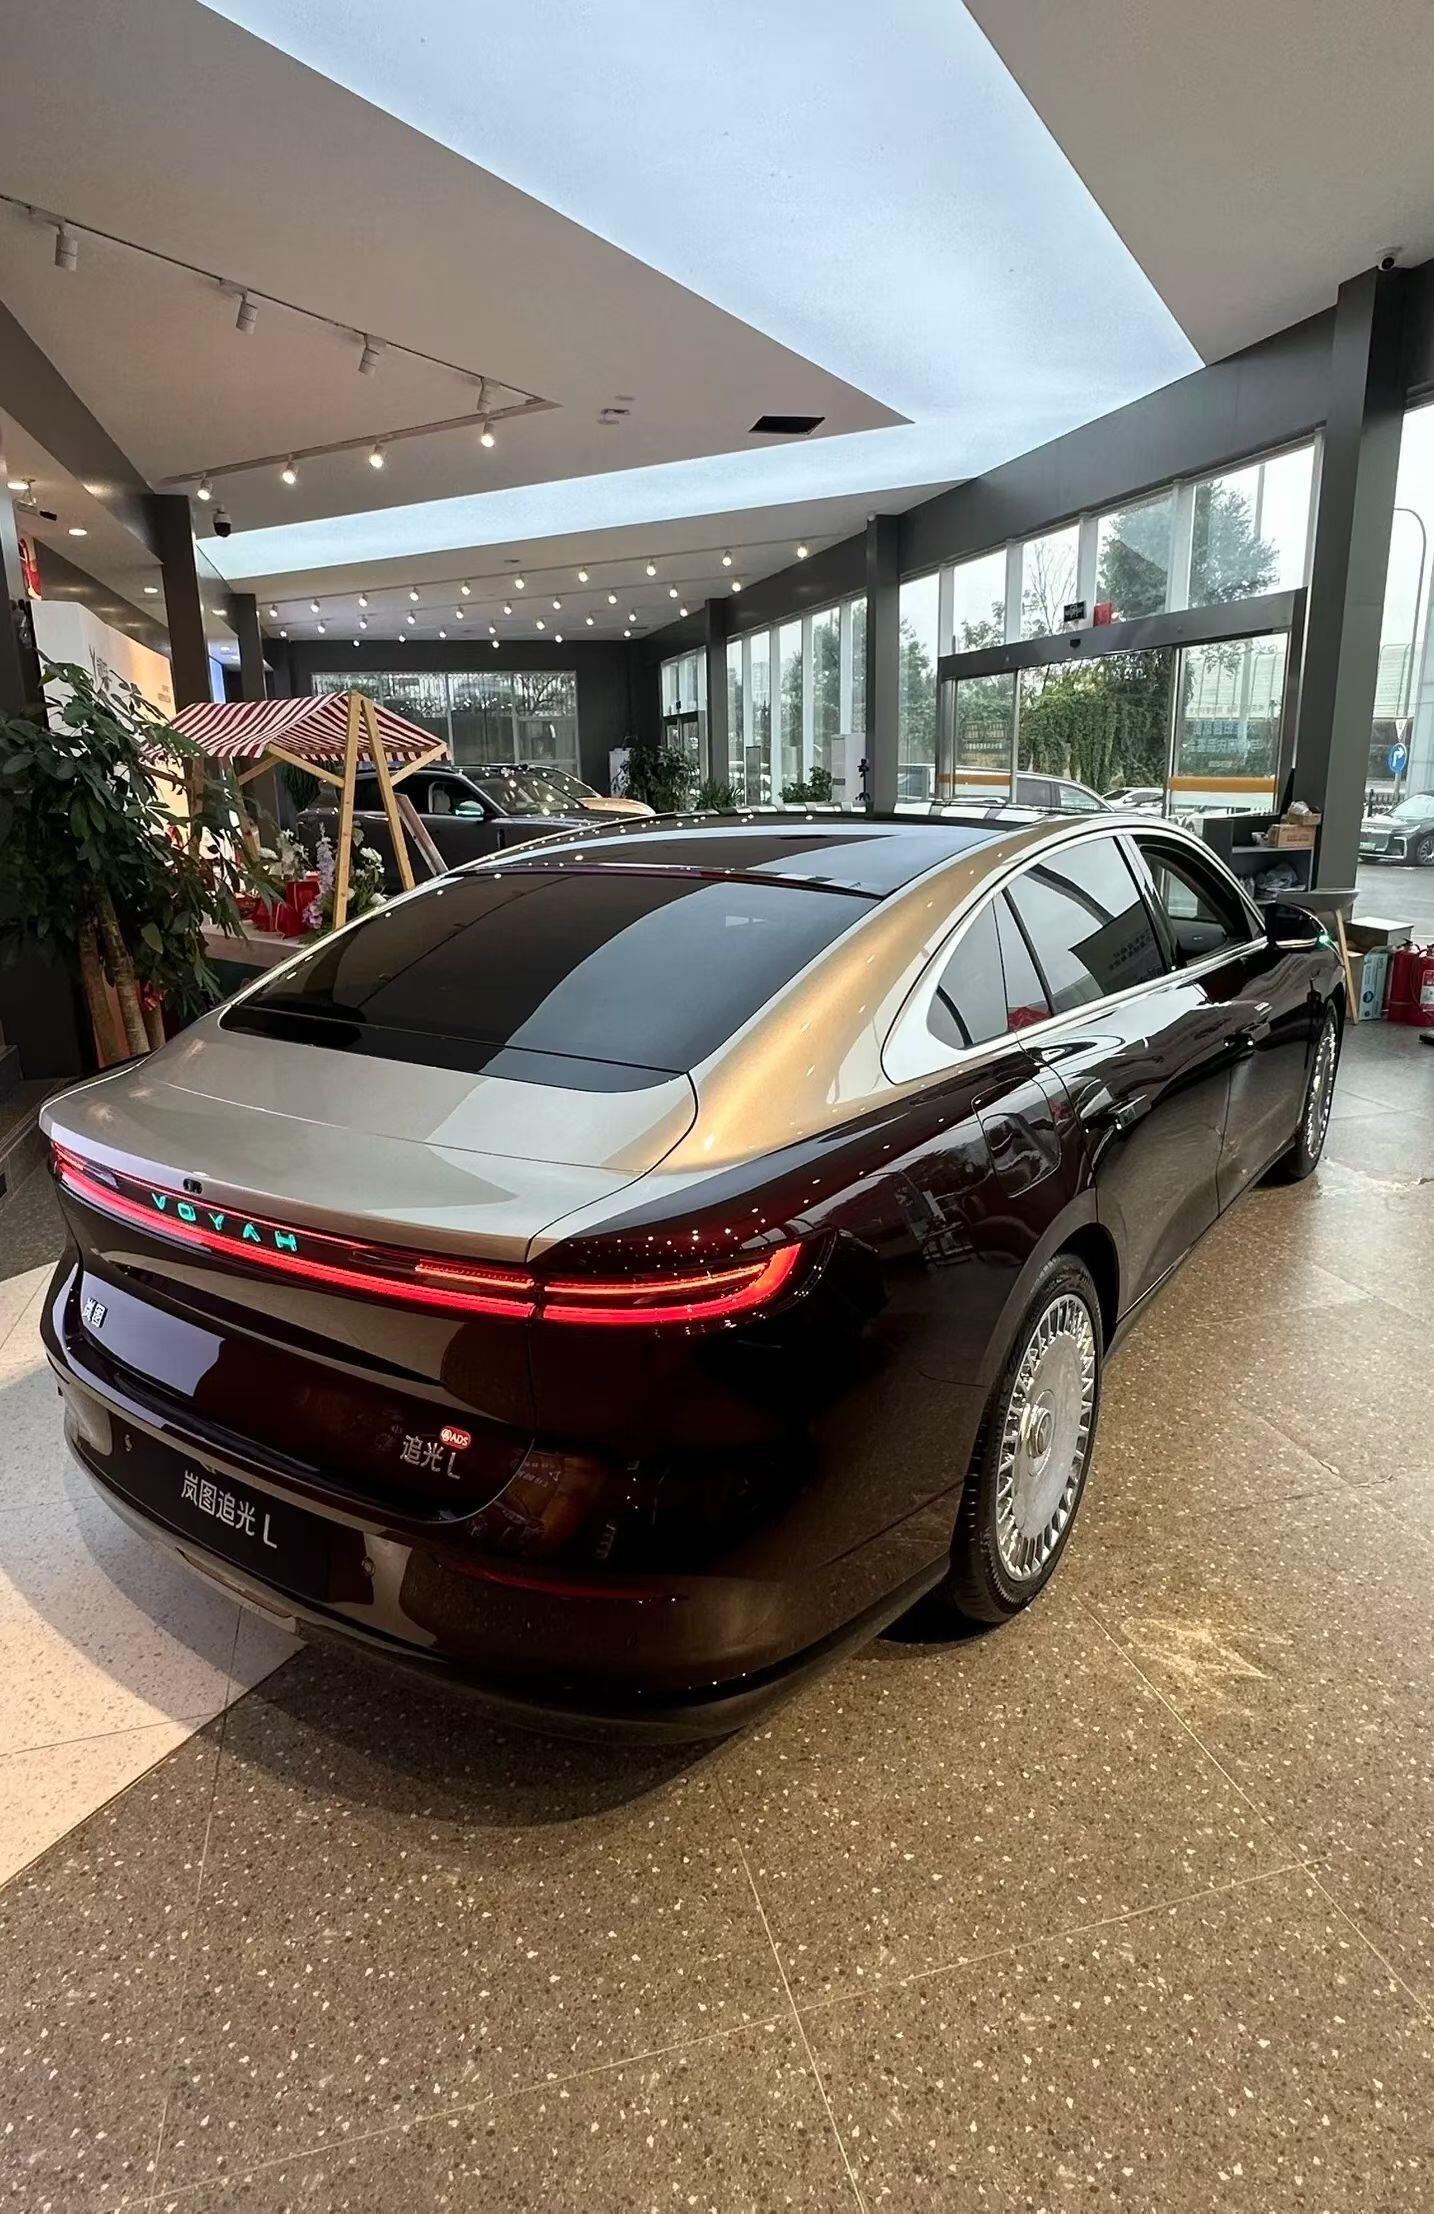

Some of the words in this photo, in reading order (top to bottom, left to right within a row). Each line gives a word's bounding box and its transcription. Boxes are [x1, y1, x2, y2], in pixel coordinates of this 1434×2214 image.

[152, 1193, 297, 1251] VOYAH
[400, 1434, 444, 1472] 追光
[181, 1470, 255, 1536] 岚图追光
